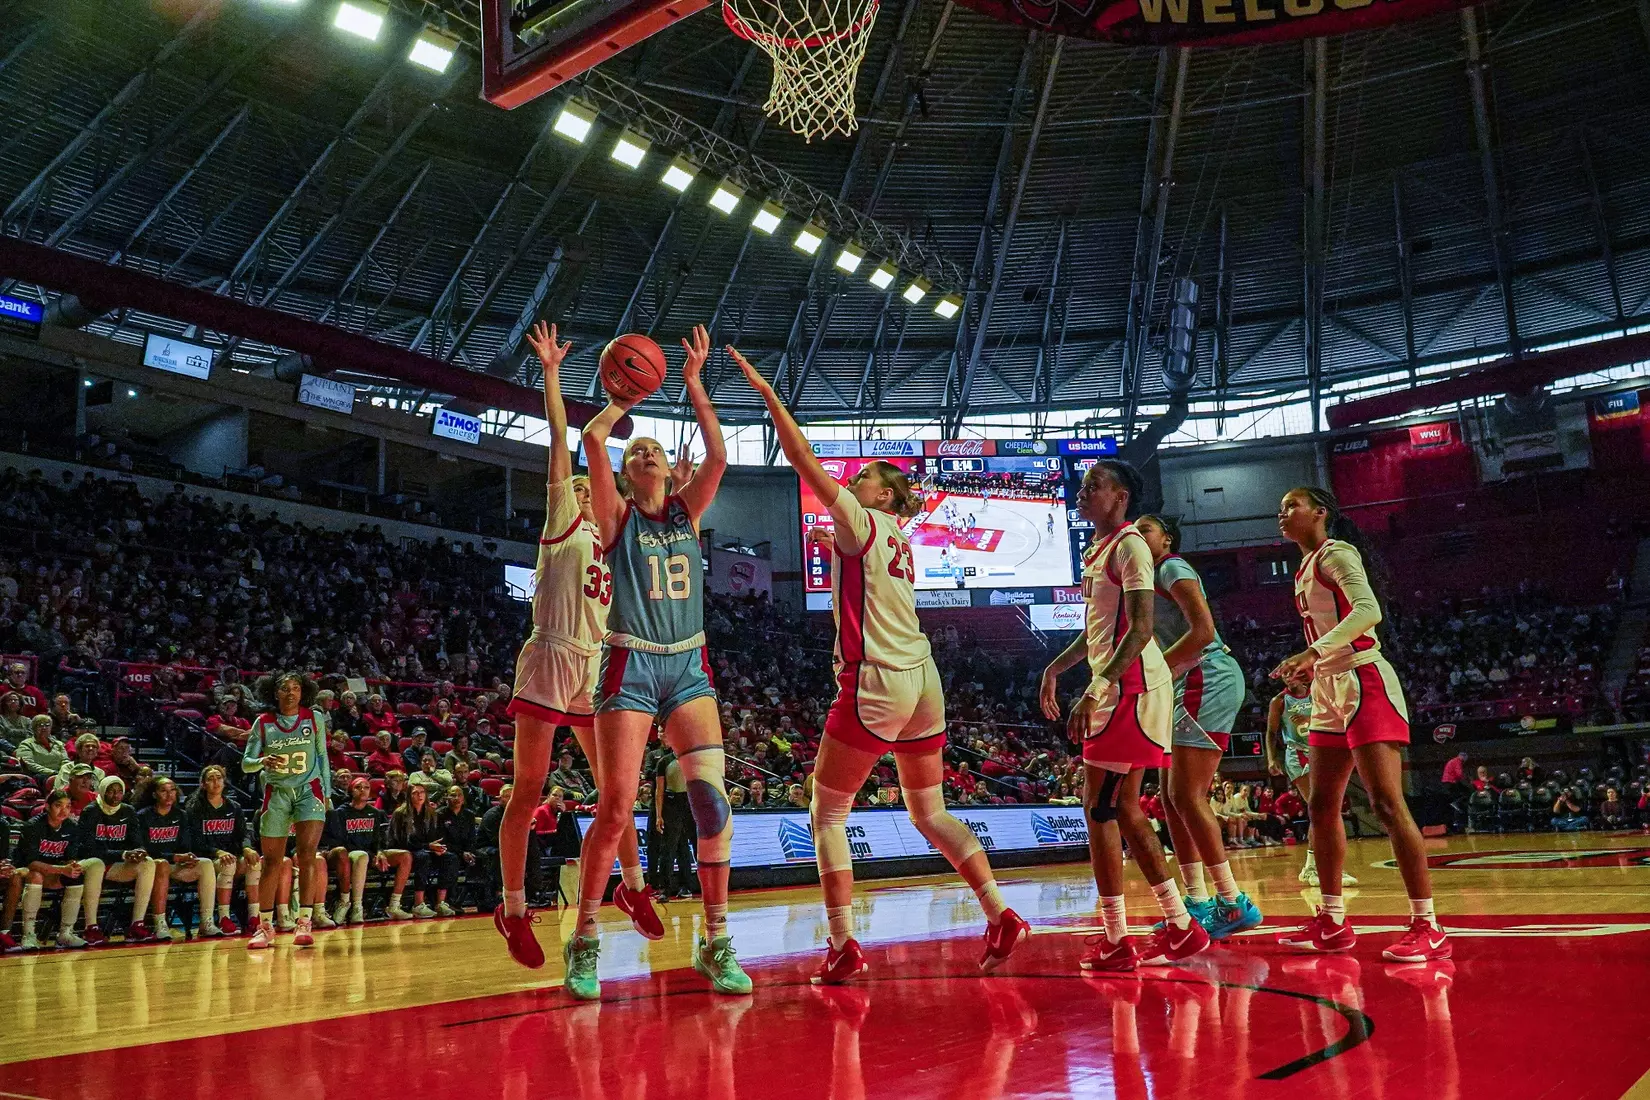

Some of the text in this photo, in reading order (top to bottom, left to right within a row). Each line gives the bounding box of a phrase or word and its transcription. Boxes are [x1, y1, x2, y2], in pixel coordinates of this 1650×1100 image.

[1608, 400, 1623, 408] FIU
[438, 412, 479, 433] ATMOS
[448, 426, 478, 440] energy
[1420, 430, 1440, 439] WKU
[873, 441, 904, 451] LOGAN
[1005, 441, 1033, 449] CHEETAH
[1079, 531, 1085, 540] 3
[813, 547, 819, 555] 3
[888, 535, 916, 585] 23
[812, 566, 823, 575] 23
[647, 553, 691, 601] 18
[813, 577, 823, 586] 33
[584, 564, 613, 606] 33
[930, 590, 955, 598] We Are
[1004, 591, 1034, 599] Builders
[916, 597, 970, 607] Kentucky's Dairy
[1052, 611, 1082, 621] Kentucky
[128, 674, 151, 682] 105
[1252, 742, 1261, 755] 2
[202, 818, 236, 832] WKU
[346, 817, 375, 830] WKU
[1047, 815, 1086, 829] Builders
[95, 823, 128, 839] WKU
[149, 825, 180, 841] WKU
[38, 839, 70, 855] WKU
